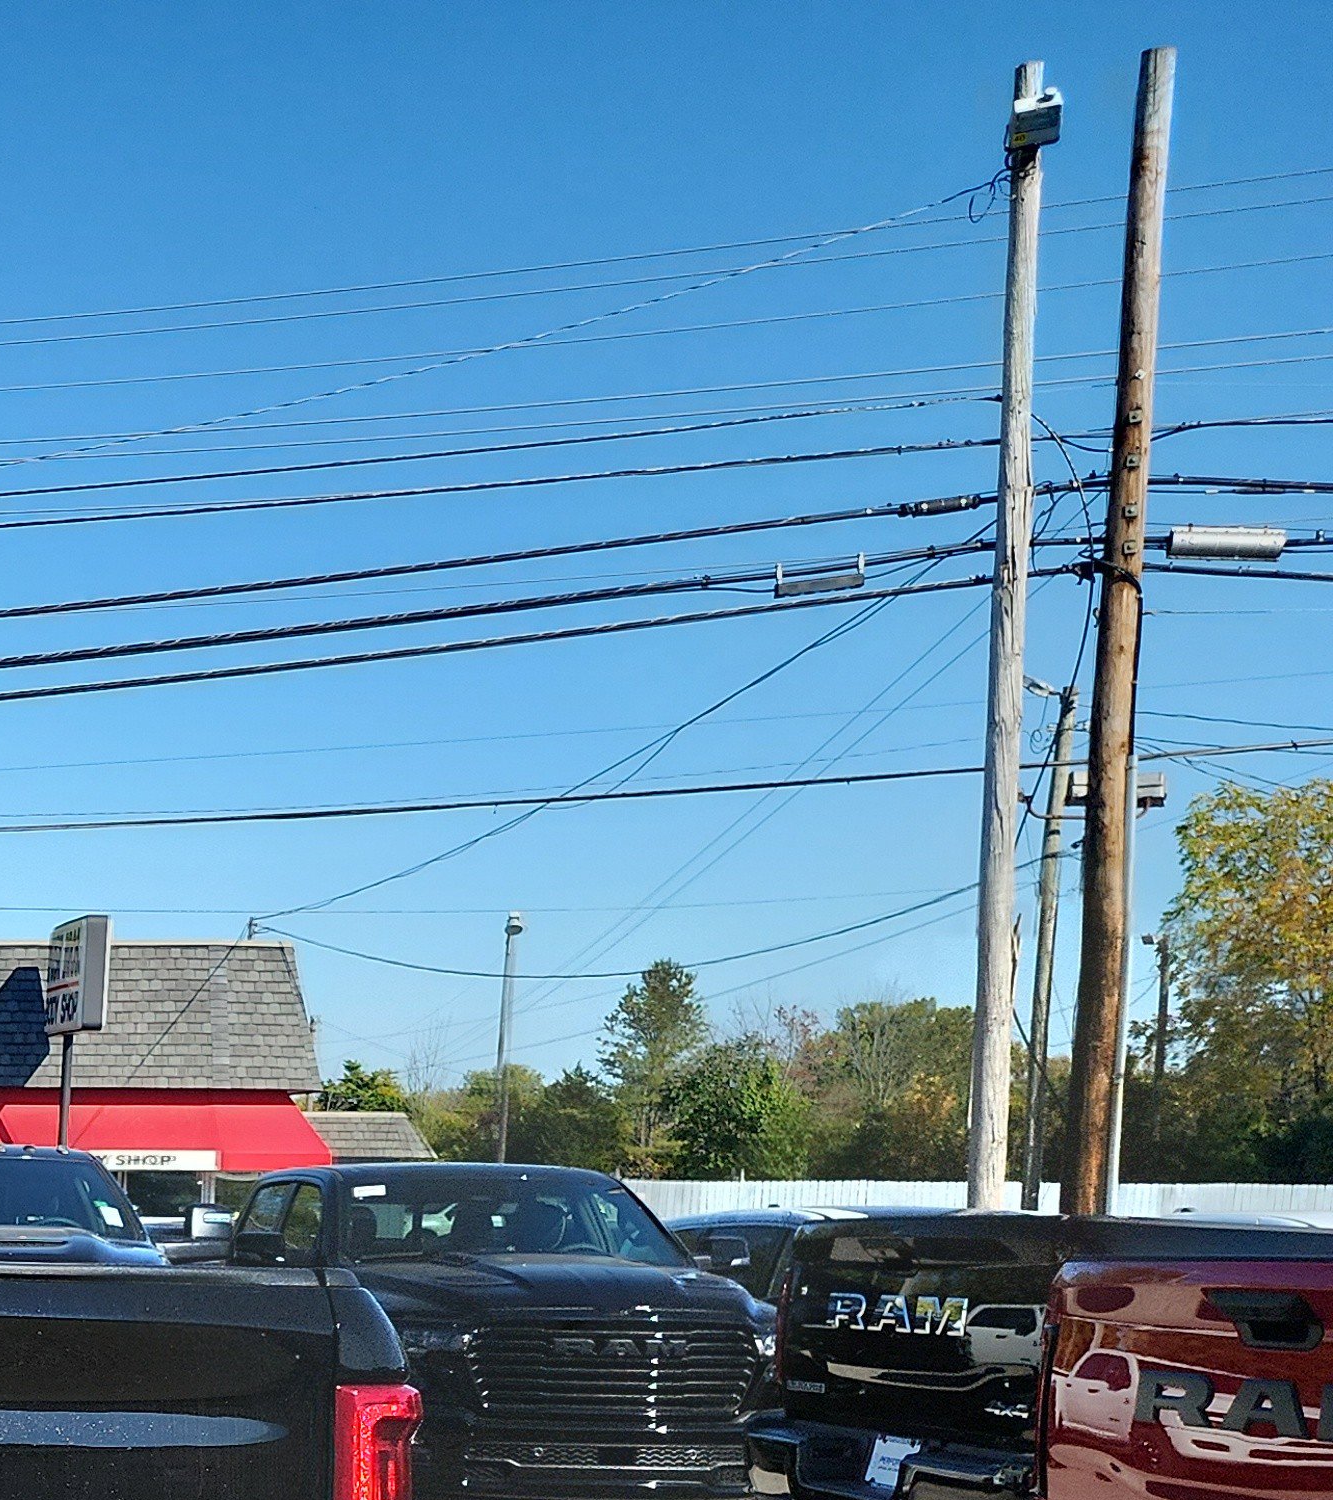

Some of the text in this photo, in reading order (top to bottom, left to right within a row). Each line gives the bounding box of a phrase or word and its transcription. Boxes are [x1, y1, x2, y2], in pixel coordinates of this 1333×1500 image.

[115, 1154, 175, 1166] SHOP
[827, 1293, 969, 1337] RAM
[553, 1338, 687, 1356] RAM
